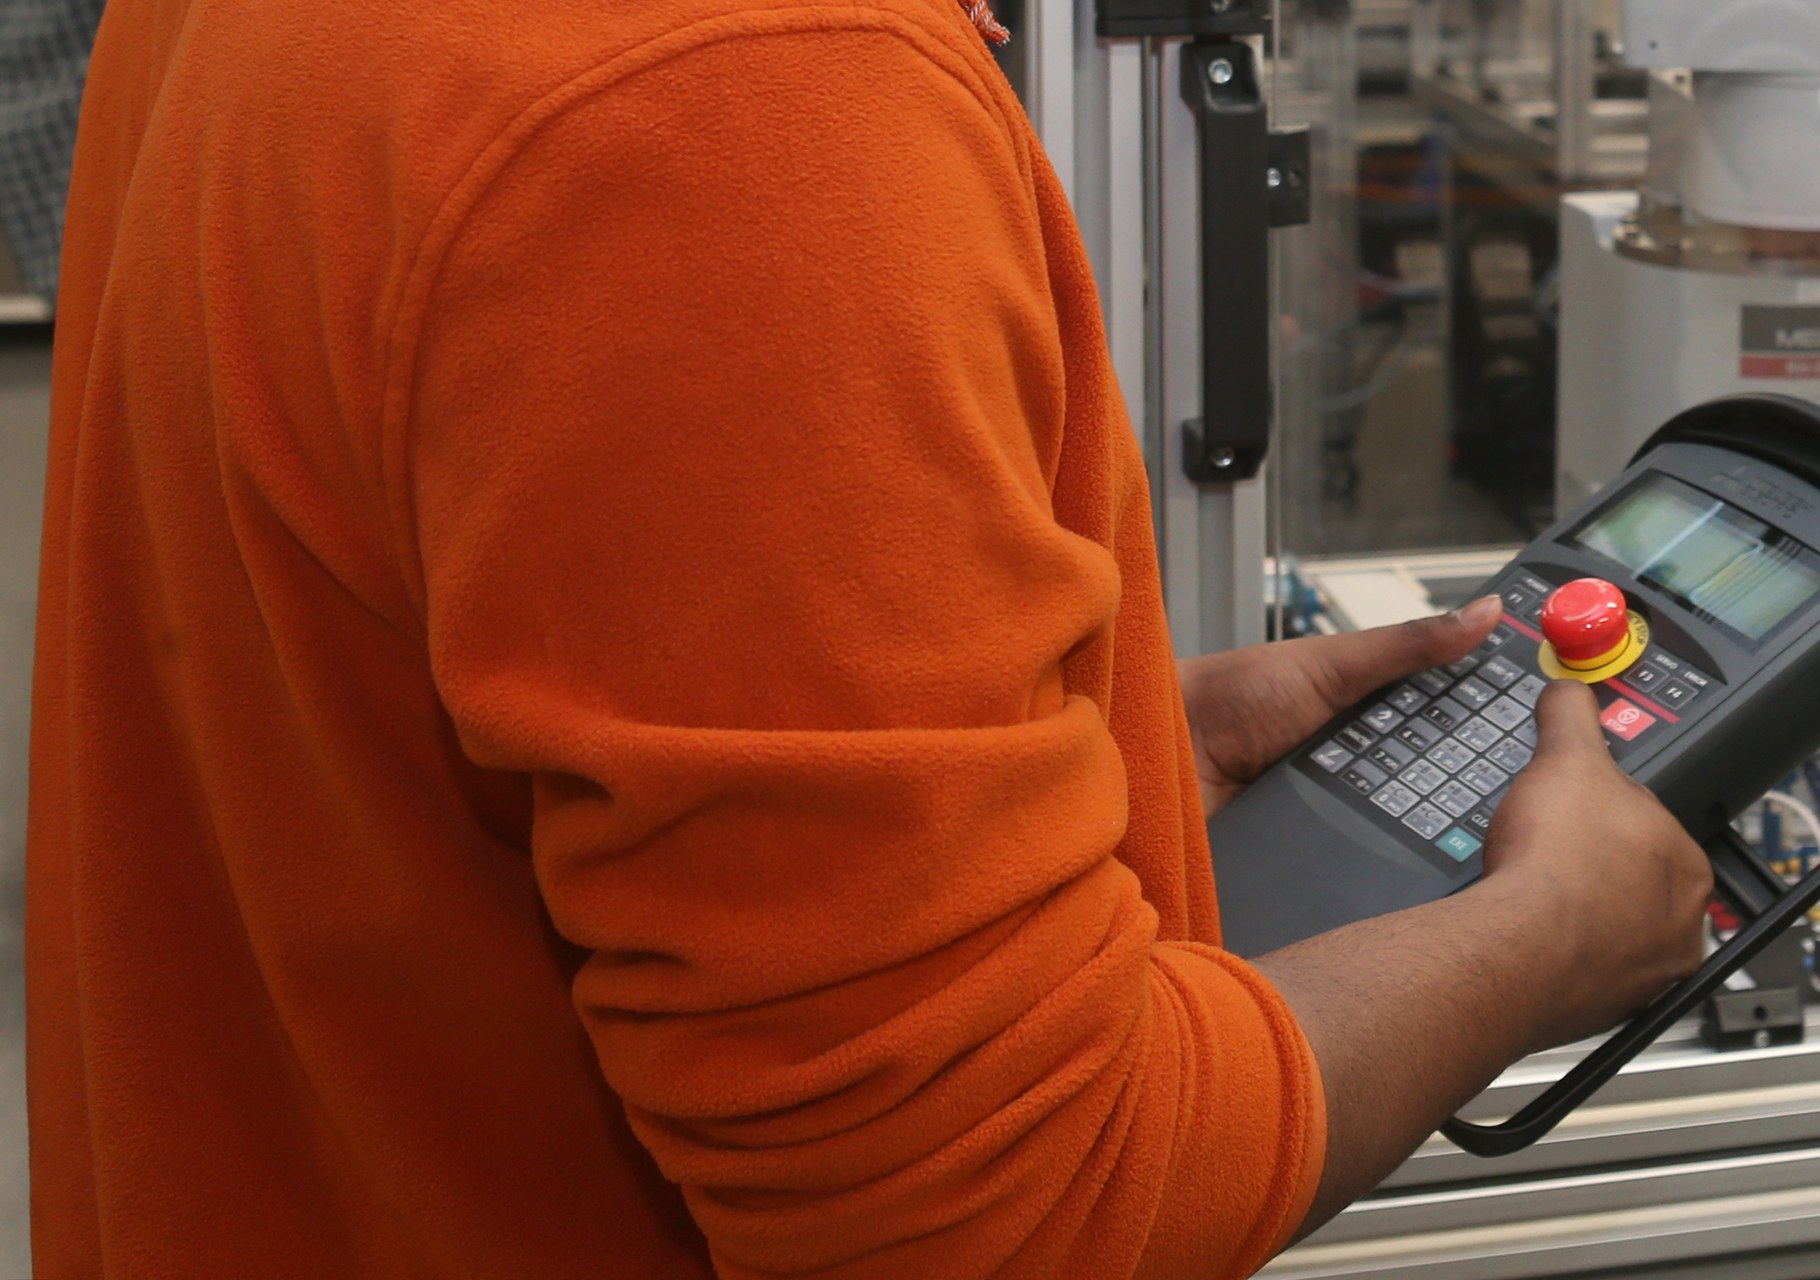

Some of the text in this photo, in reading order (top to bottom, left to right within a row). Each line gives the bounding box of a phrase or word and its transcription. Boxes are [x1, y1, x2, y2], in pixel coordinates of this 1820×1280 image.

[1638, 671, 1653, 682] F3
[1666, 687, 1681, 699] F4
[1605, 718, 1627, 733] STOP
[1471, 814, 1488, 828] CLEA
[1448, 836, 1469, 849] EXE
